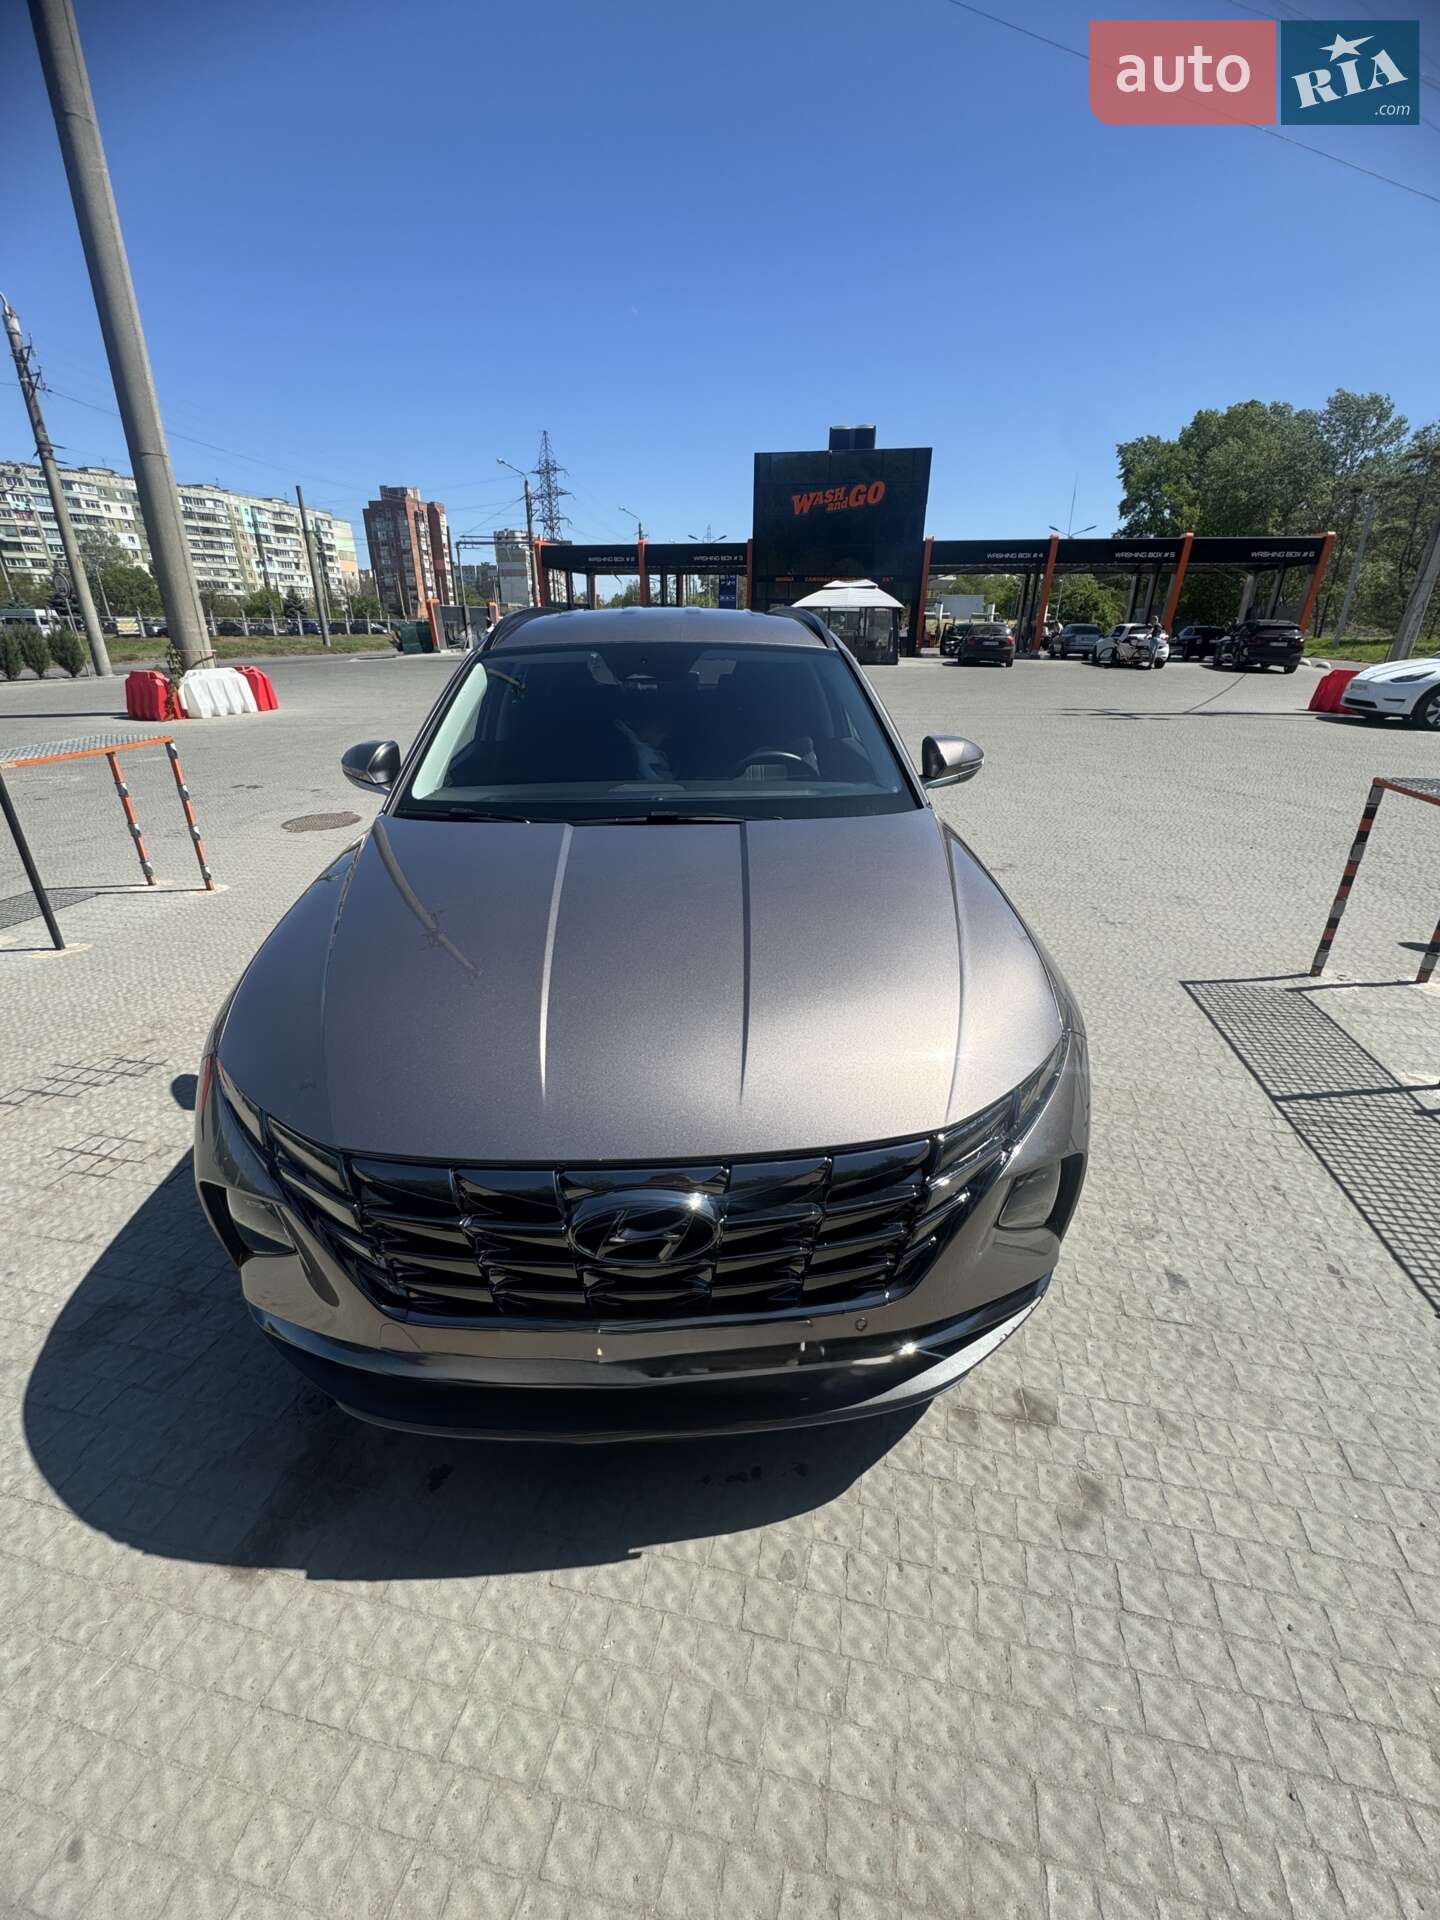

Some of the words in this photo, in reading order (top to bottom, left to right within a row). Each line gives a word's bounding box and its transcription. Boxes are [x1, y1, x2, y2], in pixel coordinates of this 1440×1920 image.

[792, 486, 847, 515] WASH
[826, 496, 848, 512] and
[848, 480, 886, 507] GO
